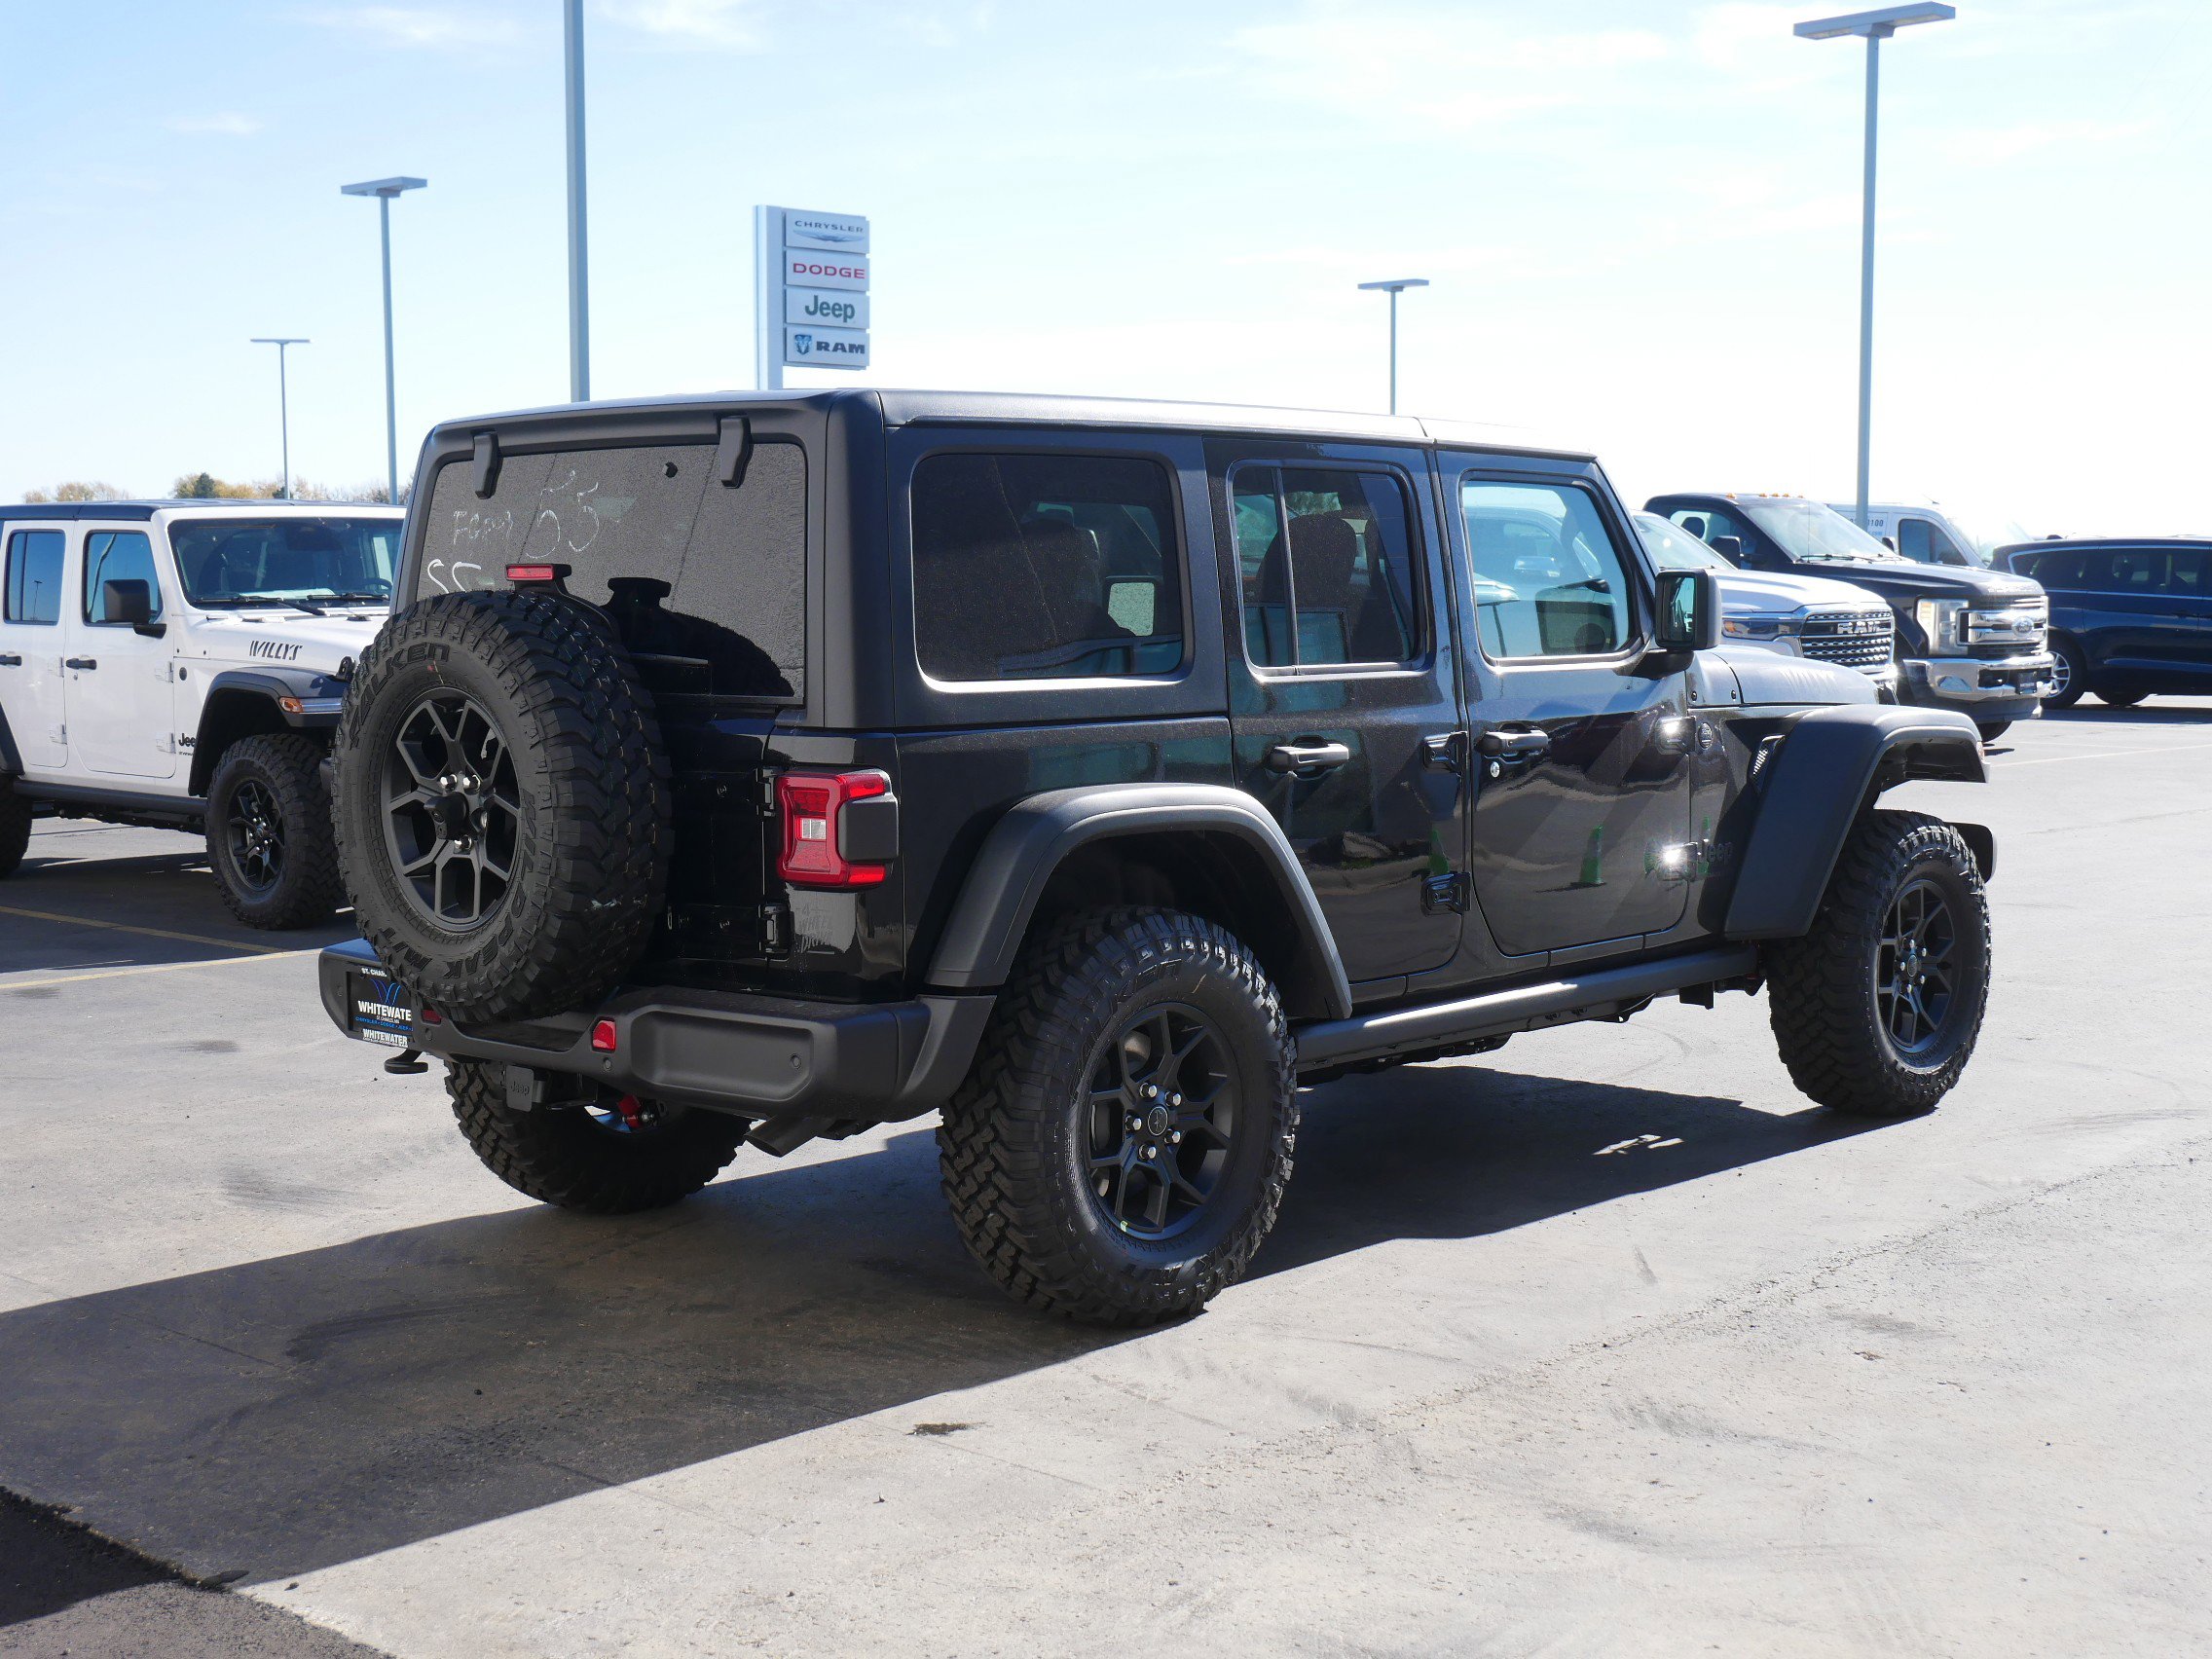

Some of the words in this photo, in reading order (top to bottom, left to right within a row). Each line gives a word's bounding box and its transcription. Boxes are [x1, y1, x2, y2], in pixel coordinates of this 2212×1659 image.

[794, 220, 864, 233] CHRYSLER
[793, 263, 866, 278] DODGE
[804, 295, 856, 323] Jeep
[816, 341, 866, 354] RAM
[249, 641, 303, 660] WILLYS
[178, 733, 196, 747] Jee
[357, 1000, 412, 1021] WHITEWATE
[362, 1028, 409, 1046] WHITEWATER
[510, 1081, 530, 1096] Jeep
